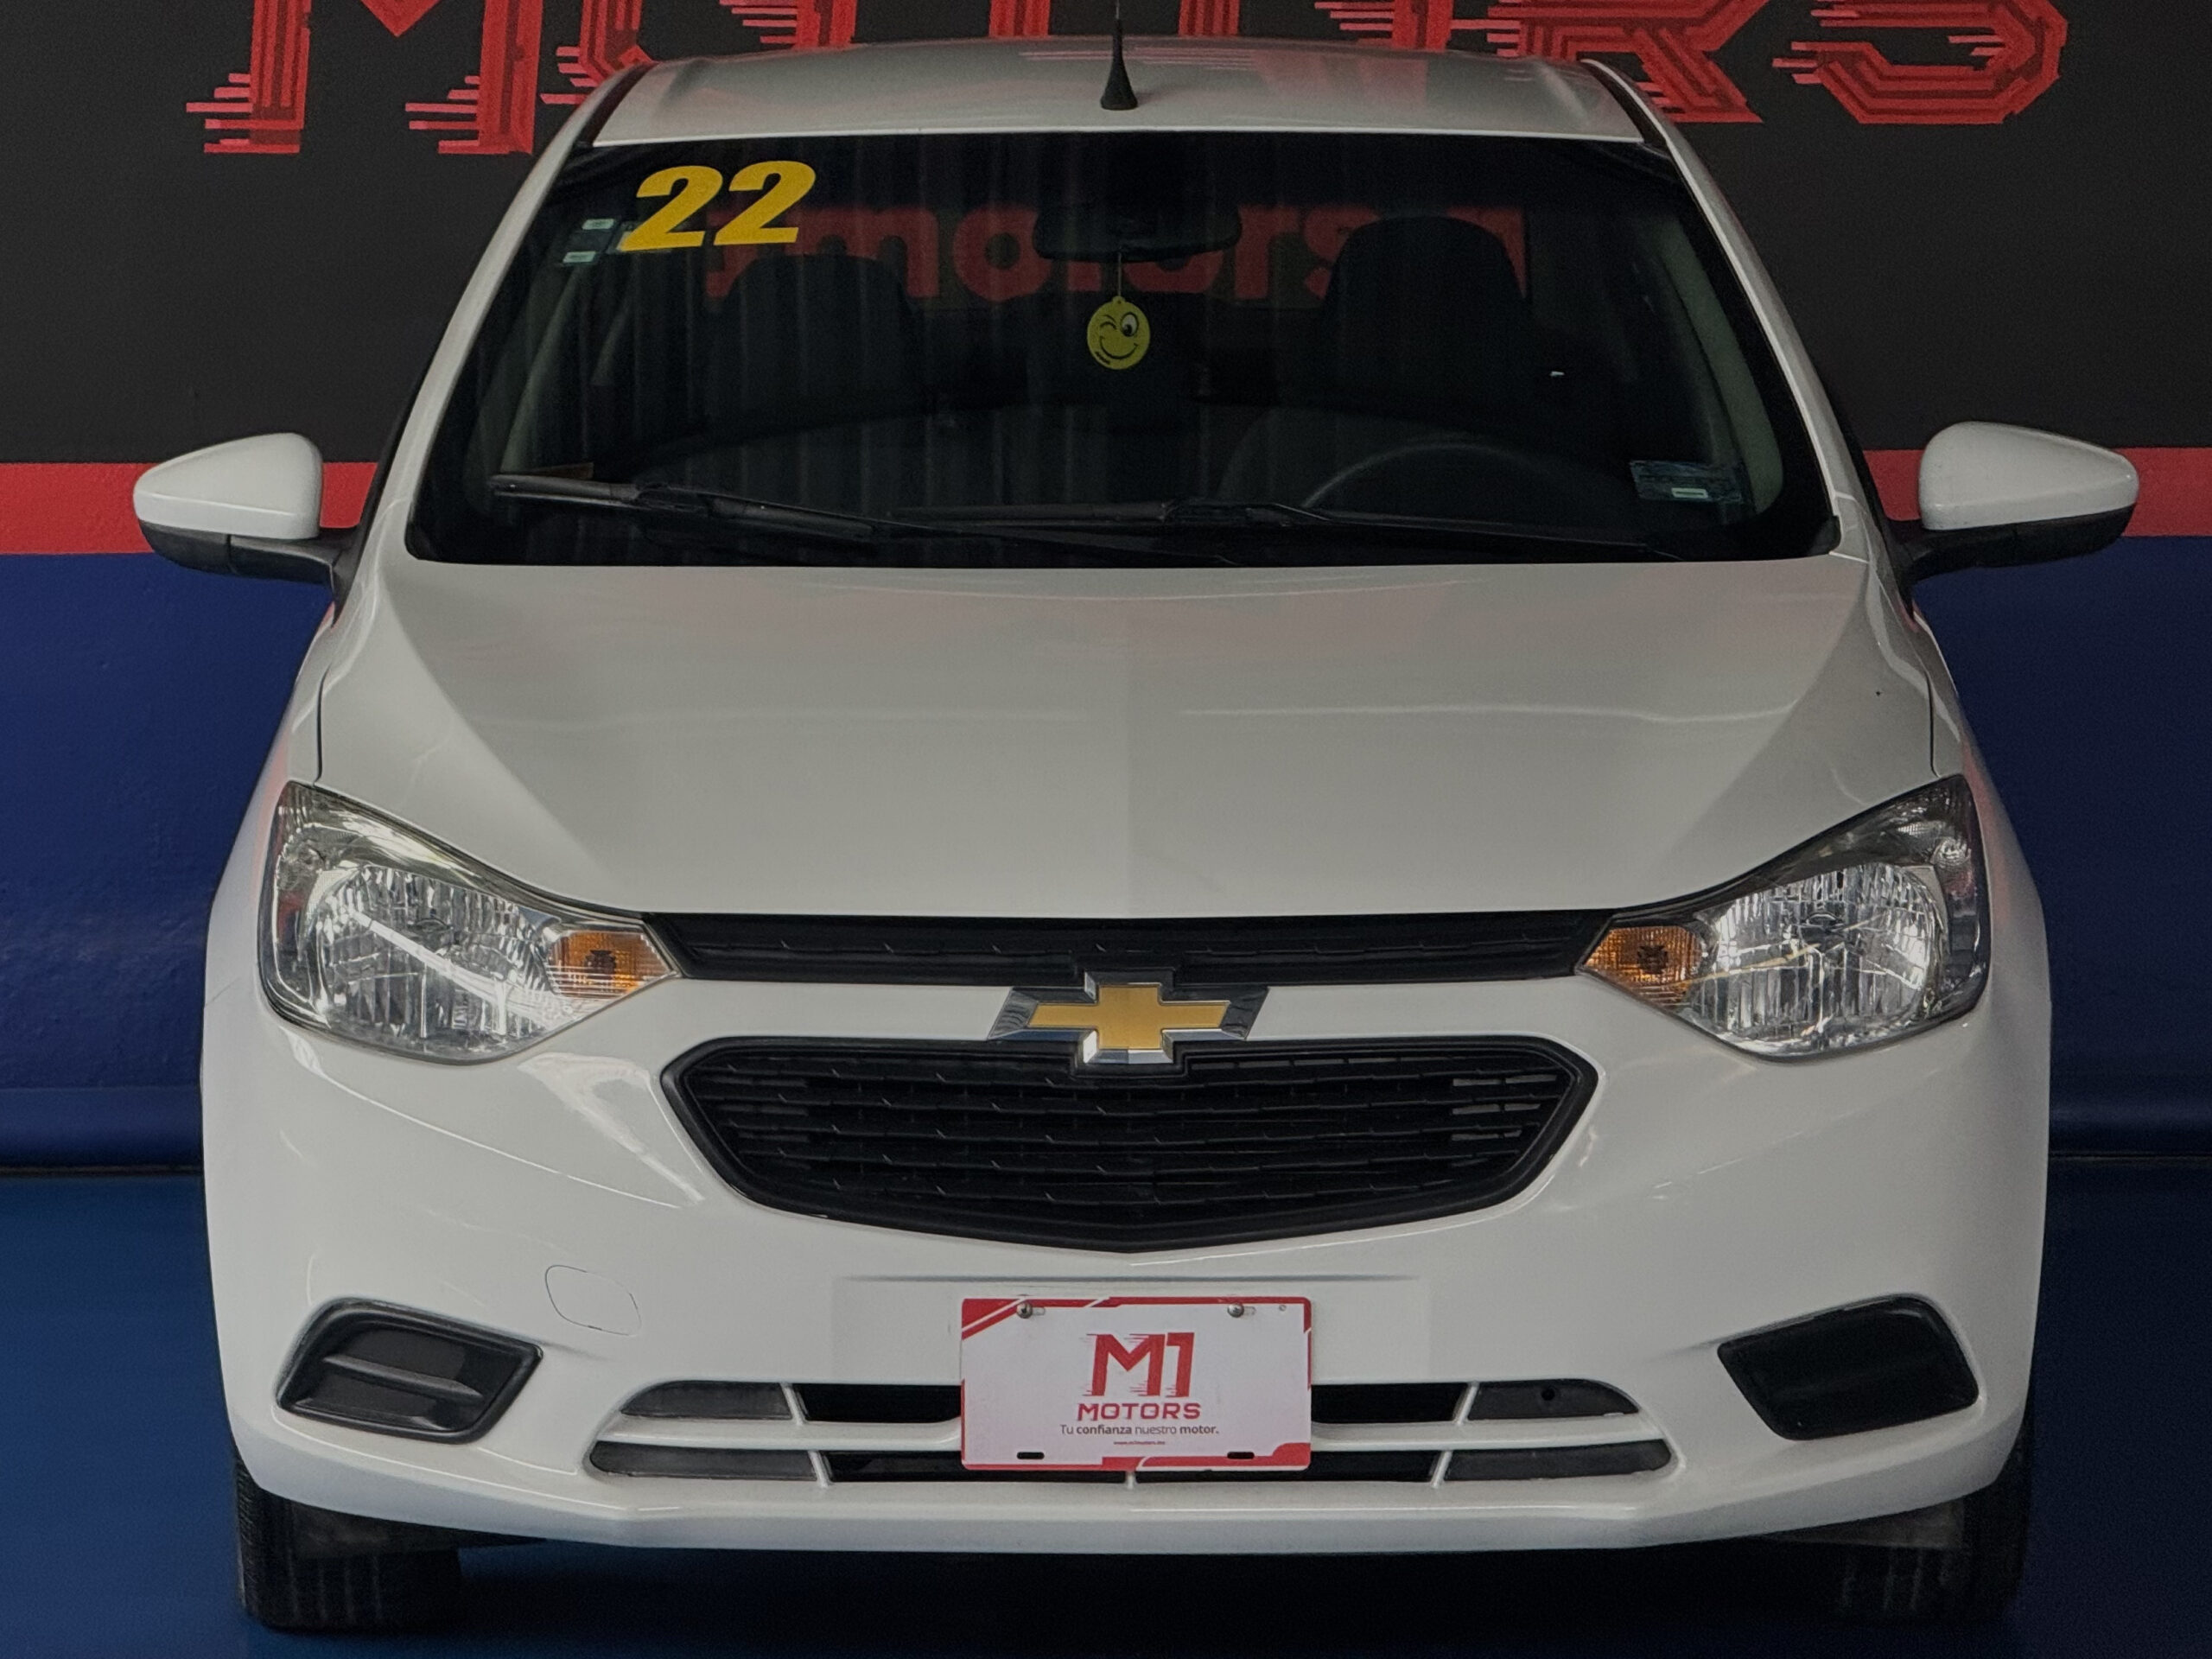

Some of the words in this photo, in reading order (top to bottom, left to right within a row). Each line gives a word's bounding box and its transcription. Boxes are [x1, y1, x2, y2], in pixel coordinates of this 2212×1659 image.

[617, 159, 816, 251] 22
[1083, 1332, 1195, 1398] M1
[1061, 1425, 1073, 1434] Tu
[1077, 1424, 1132, 1434] confianza
[1135, 1426, 1177, 1434] nuestro
[1179, 1426, 1219, 1434] motor.
[1077, 1403, 1201, 1421] MOTORS
